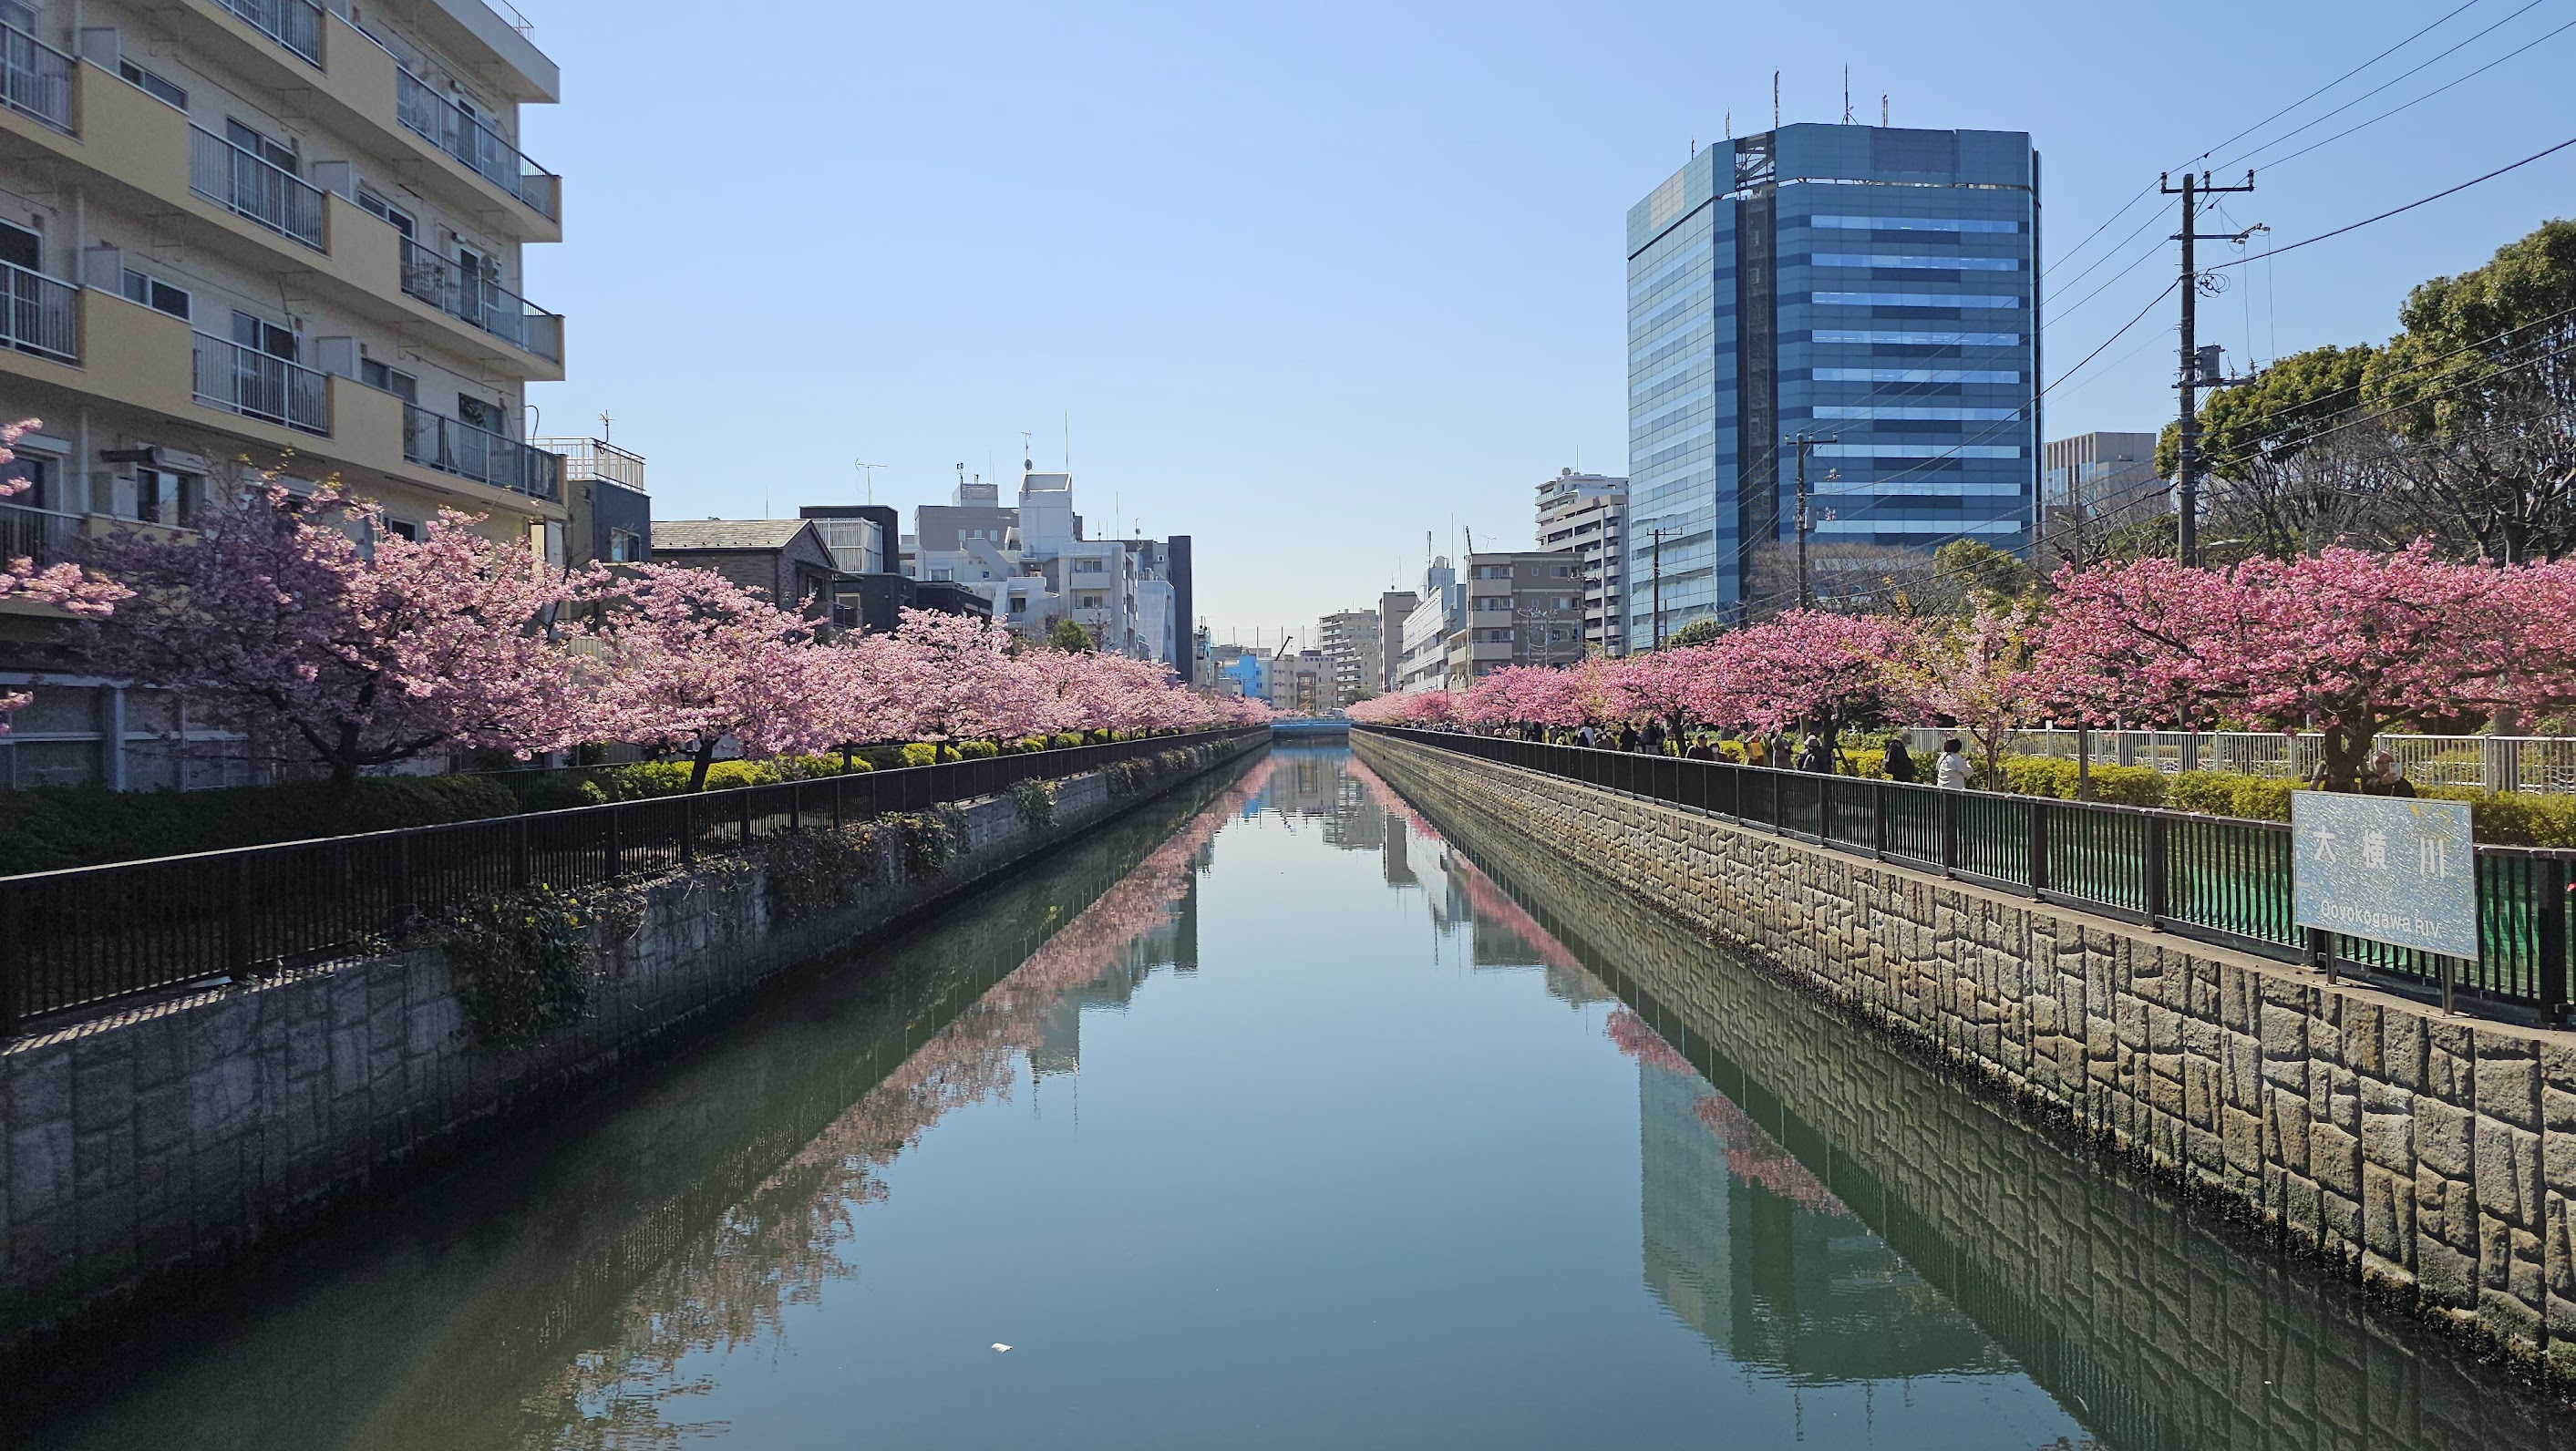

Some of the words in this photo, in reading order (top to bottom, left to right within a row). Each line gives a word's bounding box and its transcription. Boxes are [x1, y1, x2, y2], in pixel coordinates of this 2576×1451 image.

[2313, 825, 2445, 879] 大横川
[2321, 900, 2411, 932] Ooyokogawa
